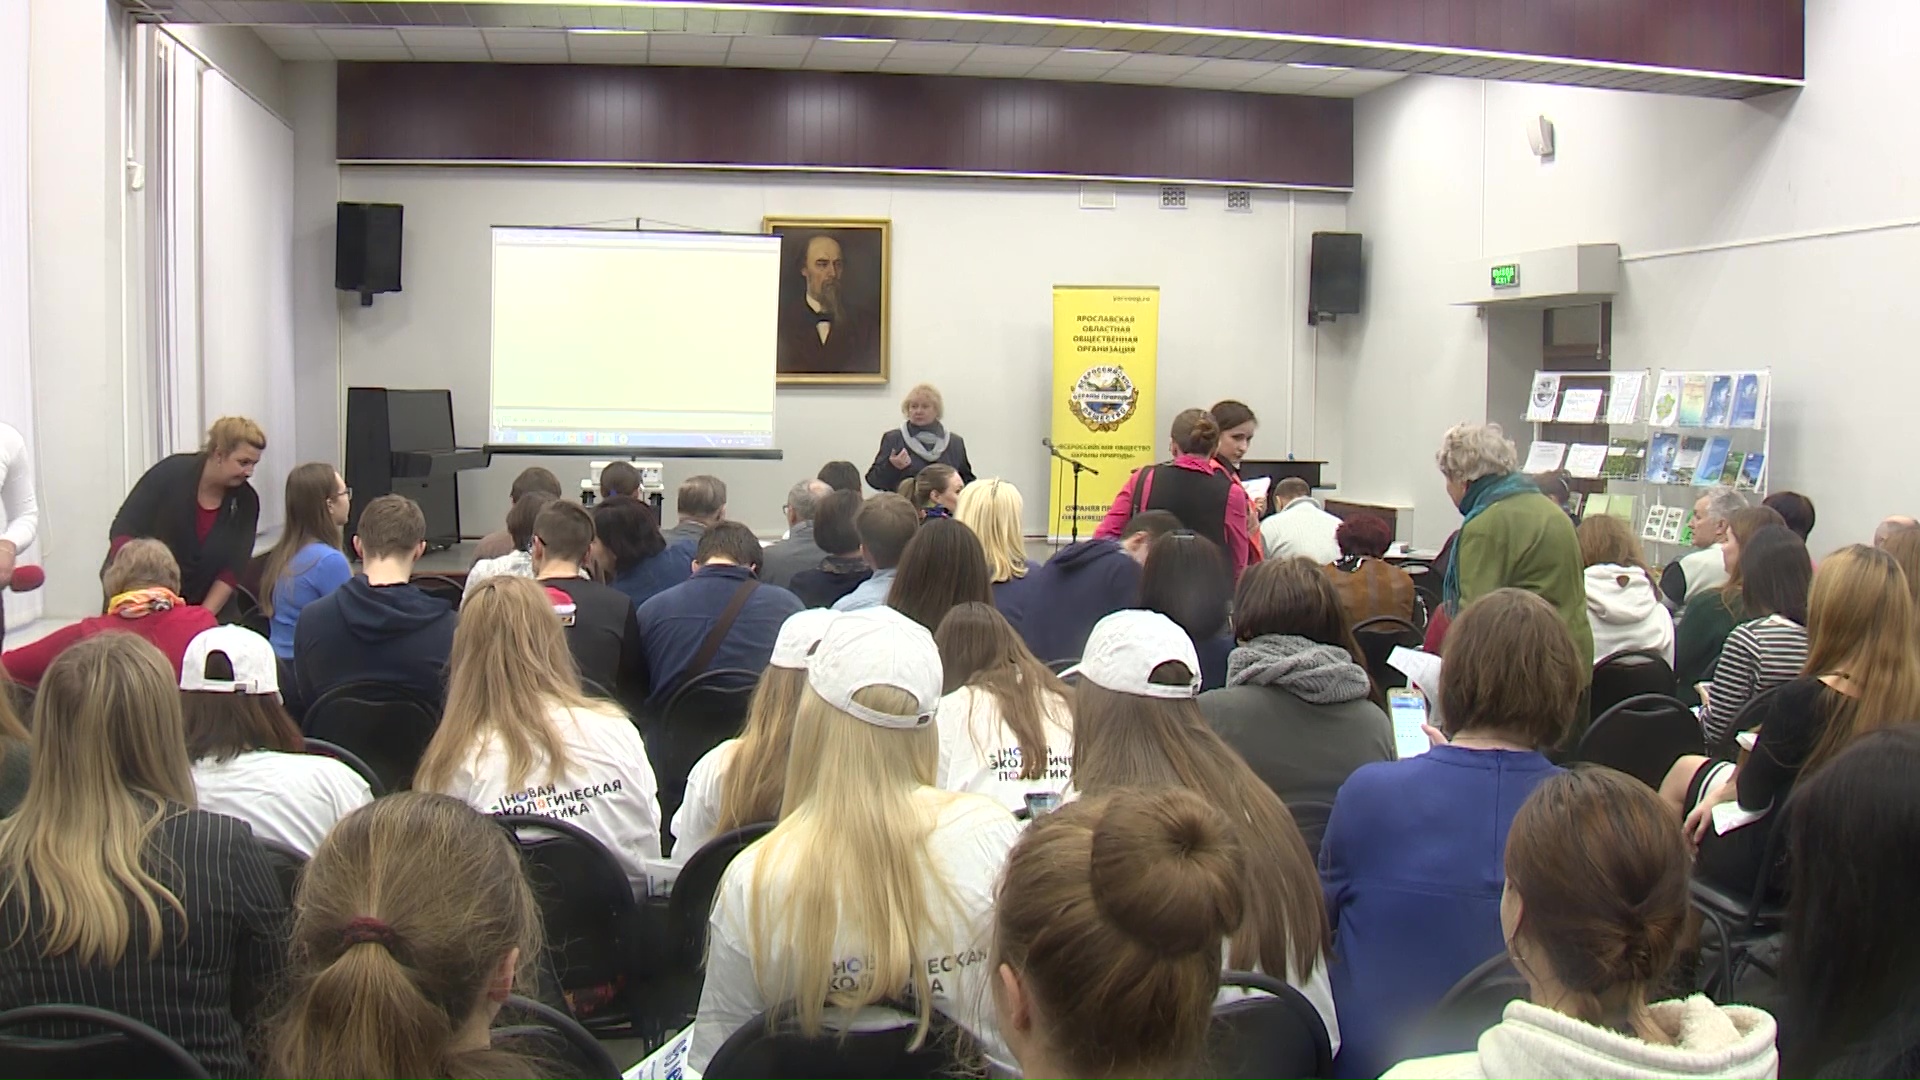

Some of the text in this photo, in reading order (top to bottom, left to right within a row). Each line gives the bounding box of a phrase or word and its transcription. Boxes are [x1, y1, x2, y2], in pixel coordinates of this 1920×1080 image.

[1495, 275, 1511, 284] EXIT
[1073, 335, 1138, 343] ОБЩЕСТВЕННАЯ
[1076, 345, 1136, 353] ОРГАНИЗАЦИЯ
[505, 783, 556, 806] НОВАЯ
